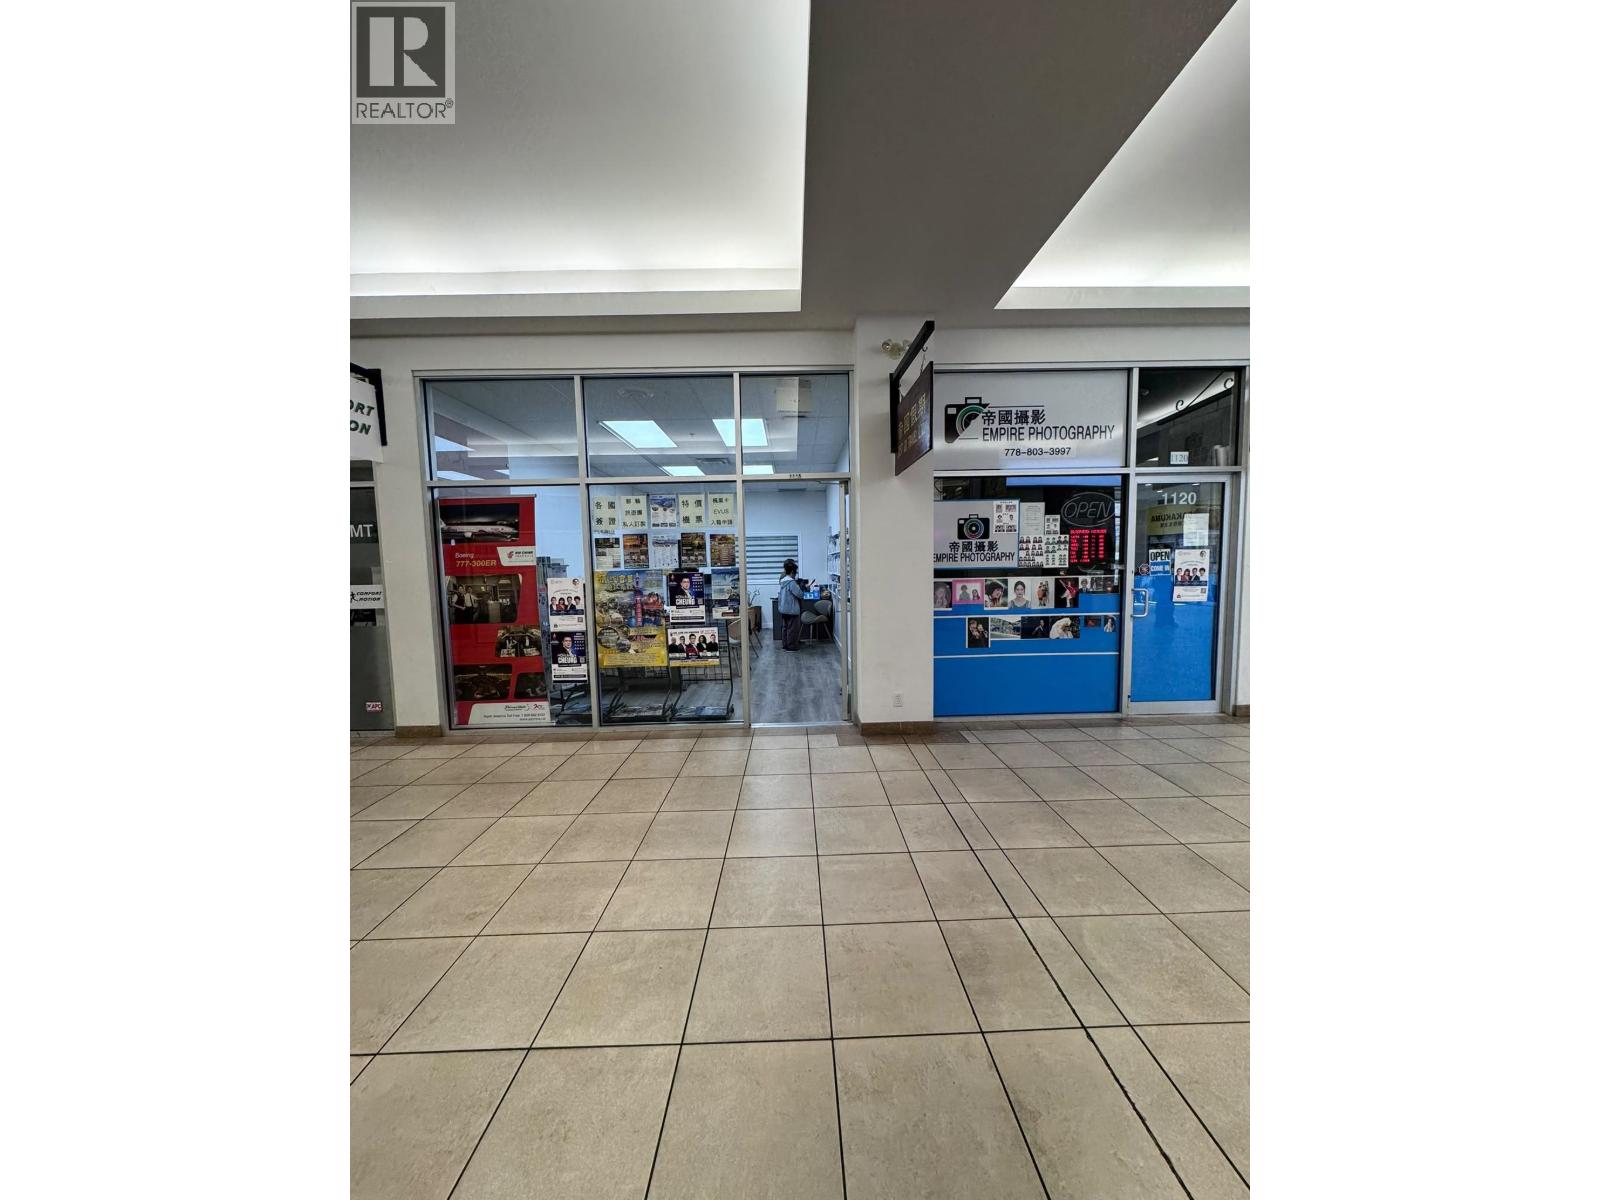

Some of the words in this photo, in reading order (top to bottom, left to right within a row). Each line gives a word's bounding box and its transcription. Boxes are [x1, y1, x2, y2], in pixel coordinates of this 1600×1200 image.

[981, 409, 1046, 426] 帝國攝影
[982, 427, 1025, 442] EMPIRE
[1028, 425, 1115, 441] PHOTOGRAPHY
[1004, 447, 1072, 457] 778-803-3997
[1162, 492, 1197, 505] 1120
[1064, 501, 1112, 518] OPEN
[949, 540, 999, 552] 帝國攝影
[960, 552, 1015, 562] PHOTOGRAPHY
[1150, 550, 1170, 561] OPEN
[456, 560, 497, 568] 777-300ER
[675, 598, 696, 606] CHEUNG
